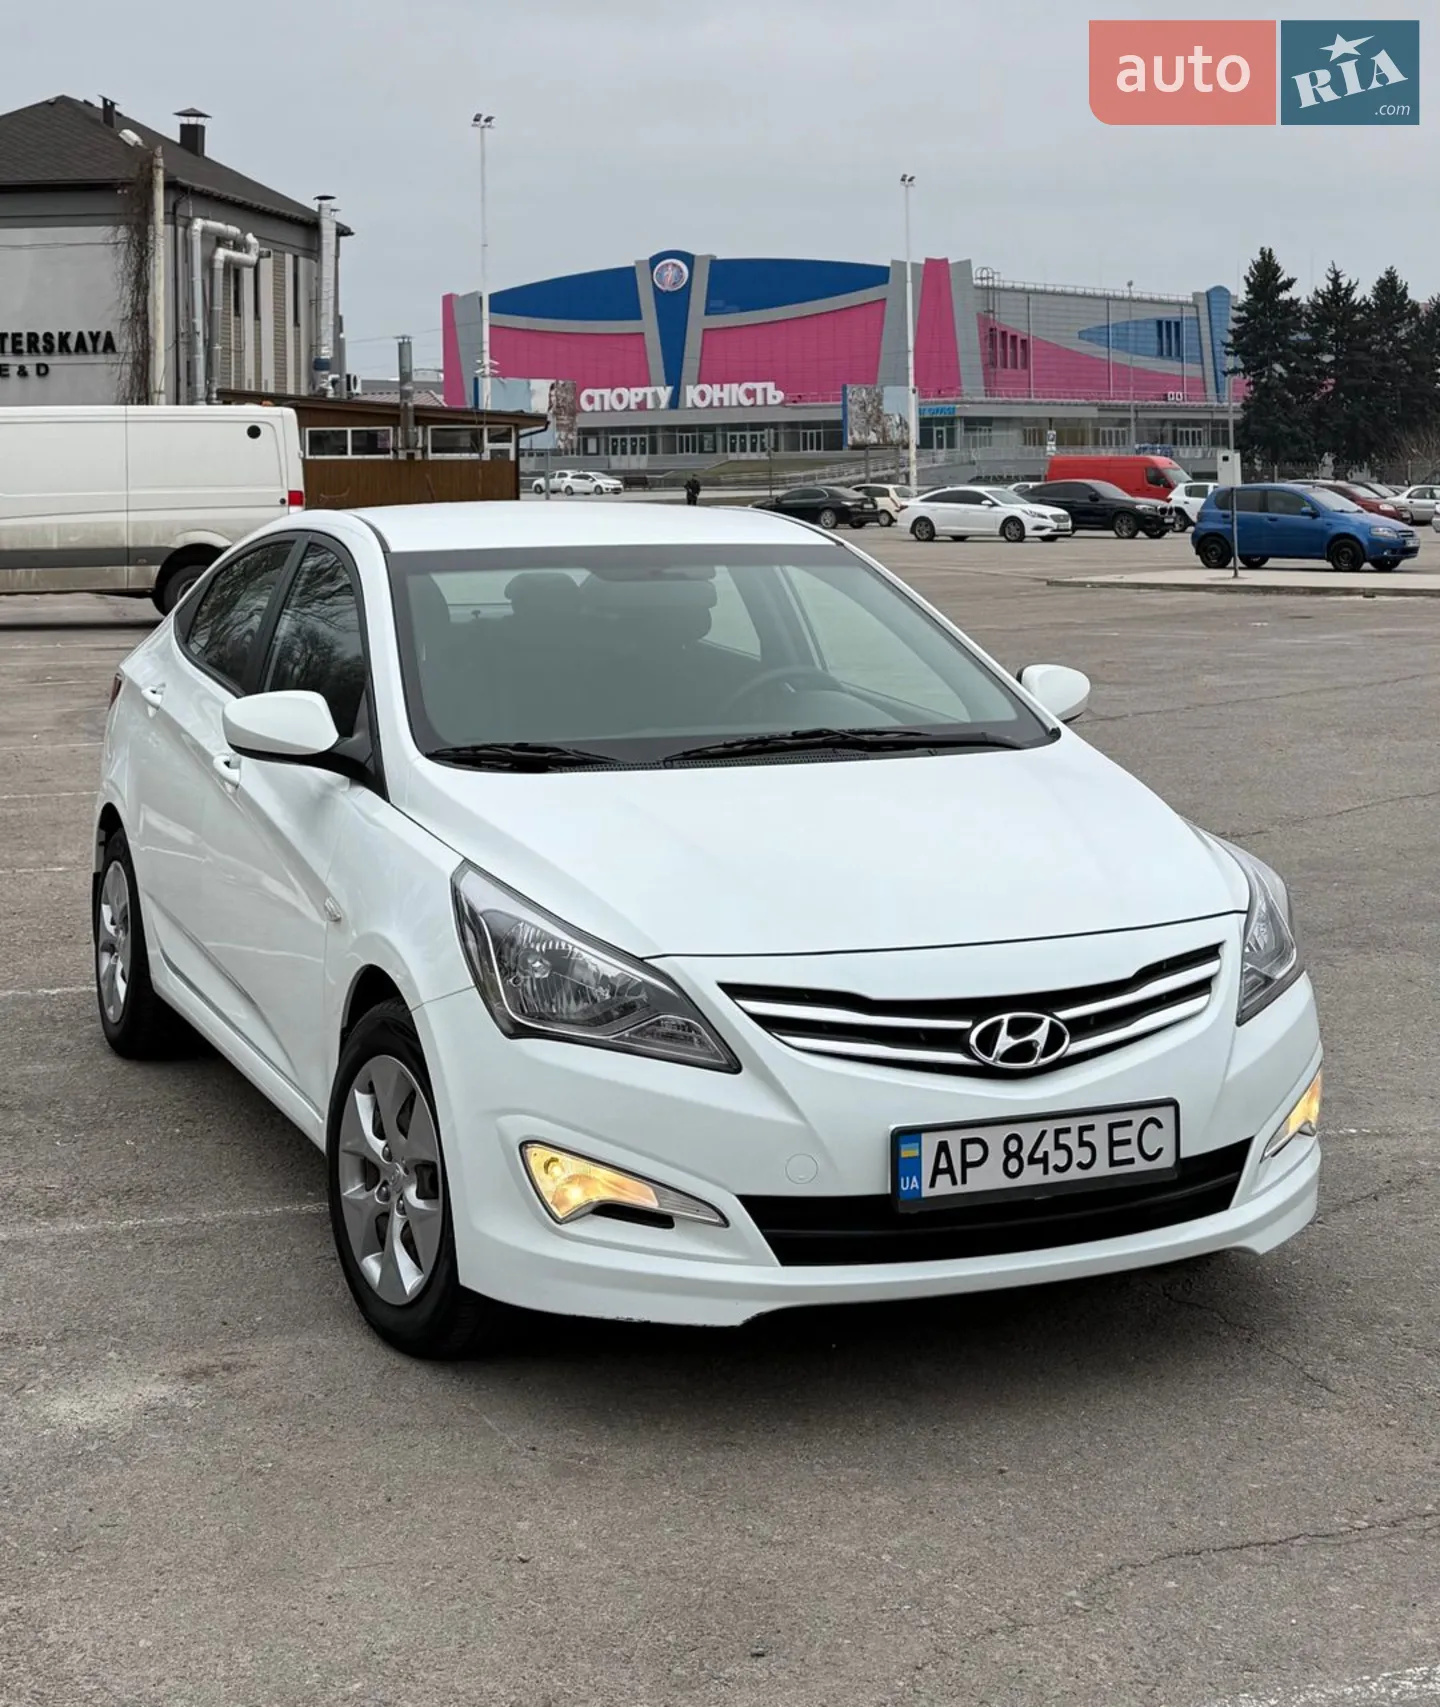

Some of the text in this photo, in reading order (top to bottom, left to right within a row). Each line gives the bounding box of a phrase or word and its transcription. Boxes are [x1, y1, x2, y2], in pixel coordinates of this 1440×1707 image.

[0, 331, 117, 354] TERSKAYA
[36, 362, 49, 377] D
[580, 381, 784, 412] СПОРТУ ЮНІСТЬ
[929, 1116, 1164, 1188] AP 8455 EC
[901, 1176, 919, 1191] UA
